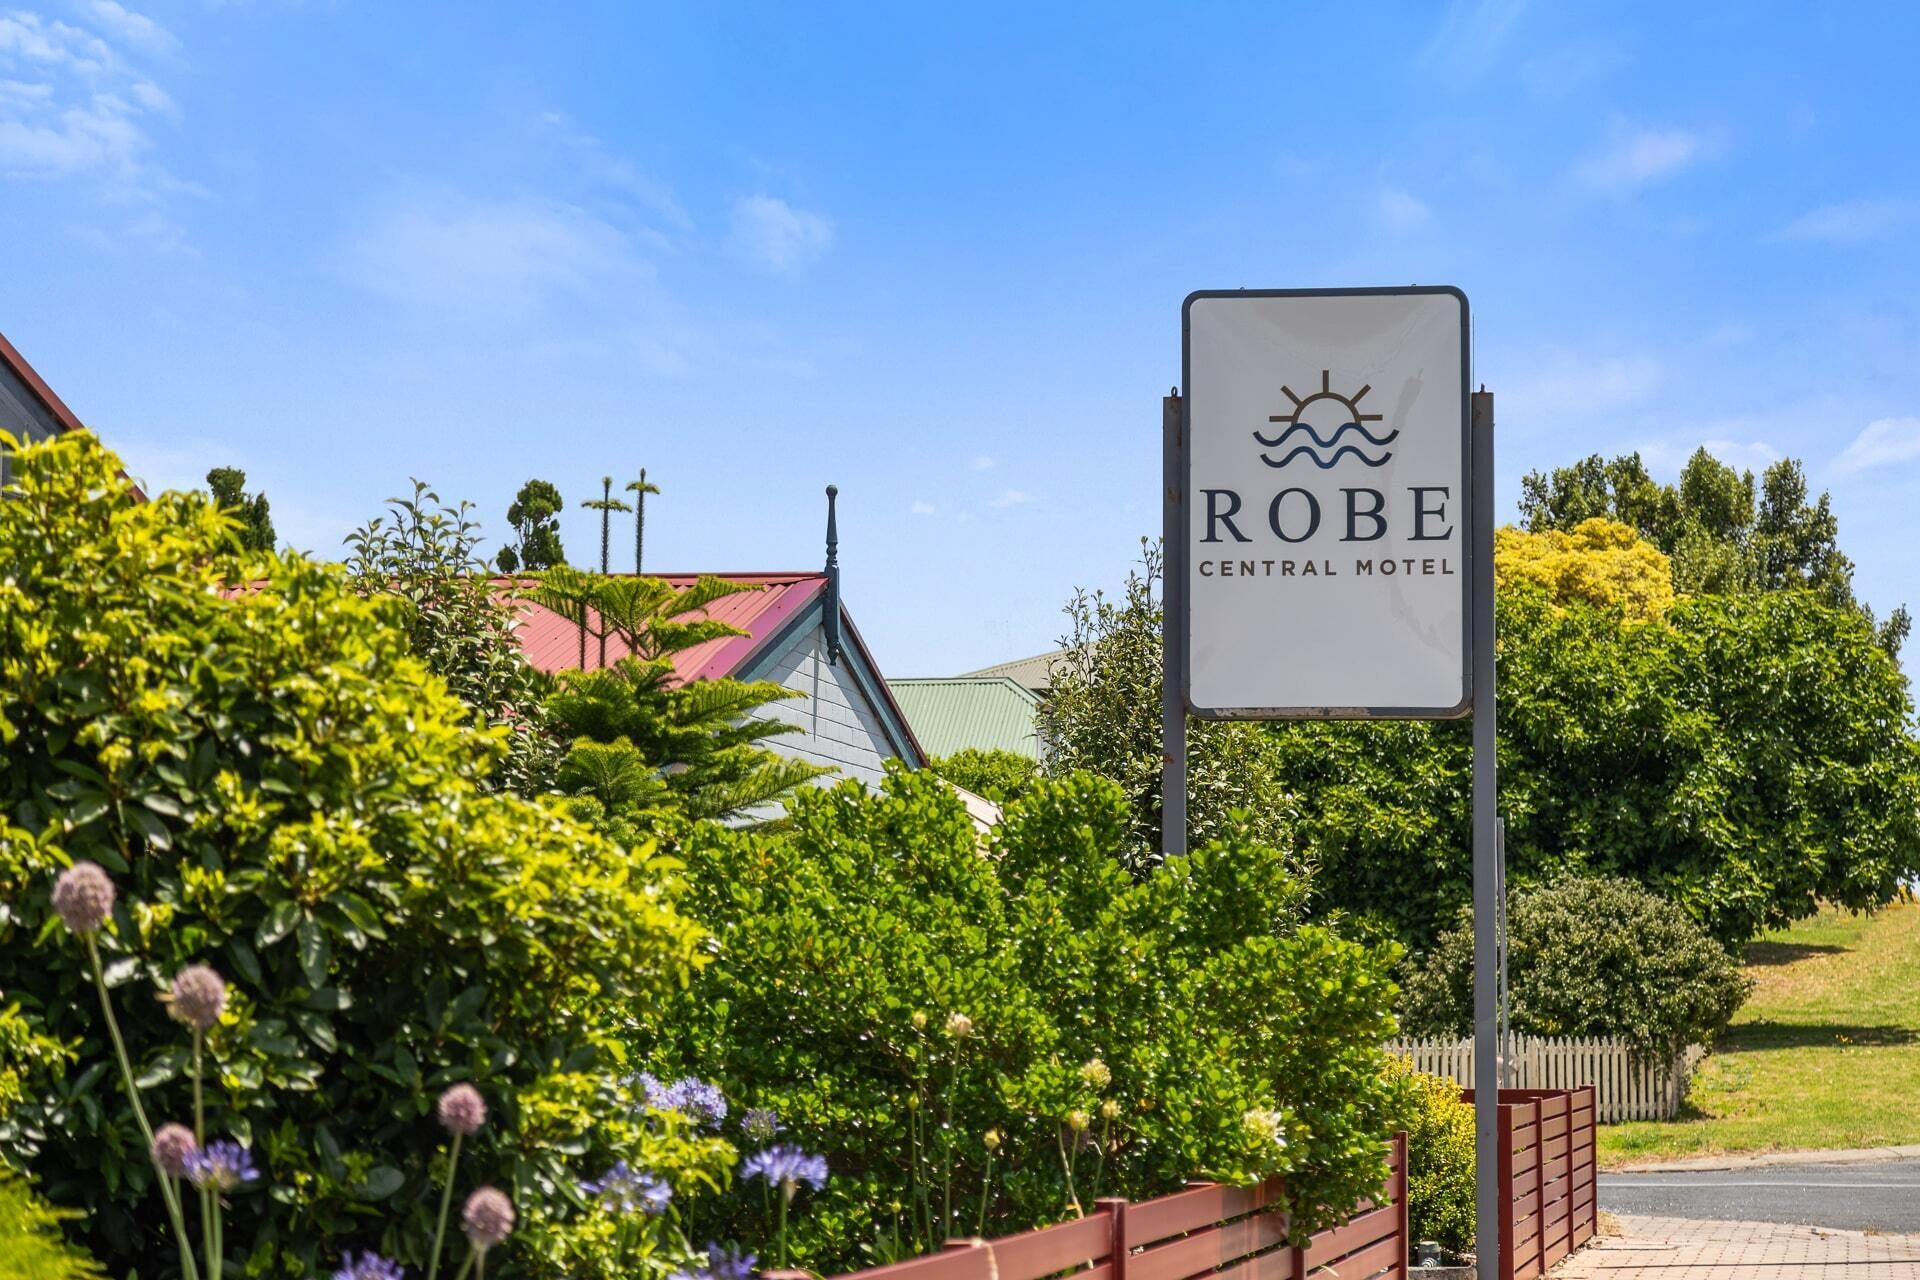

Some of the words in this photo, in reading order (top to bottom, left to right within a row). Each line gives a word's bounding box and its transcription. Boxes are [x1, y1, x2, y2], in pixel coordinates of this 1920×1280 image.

[1199, 486, 1454, 543] ROBE
[1199, 559, 1338, 577] CENTRAL
[1355, 558, 1455, 576] MOTEL
